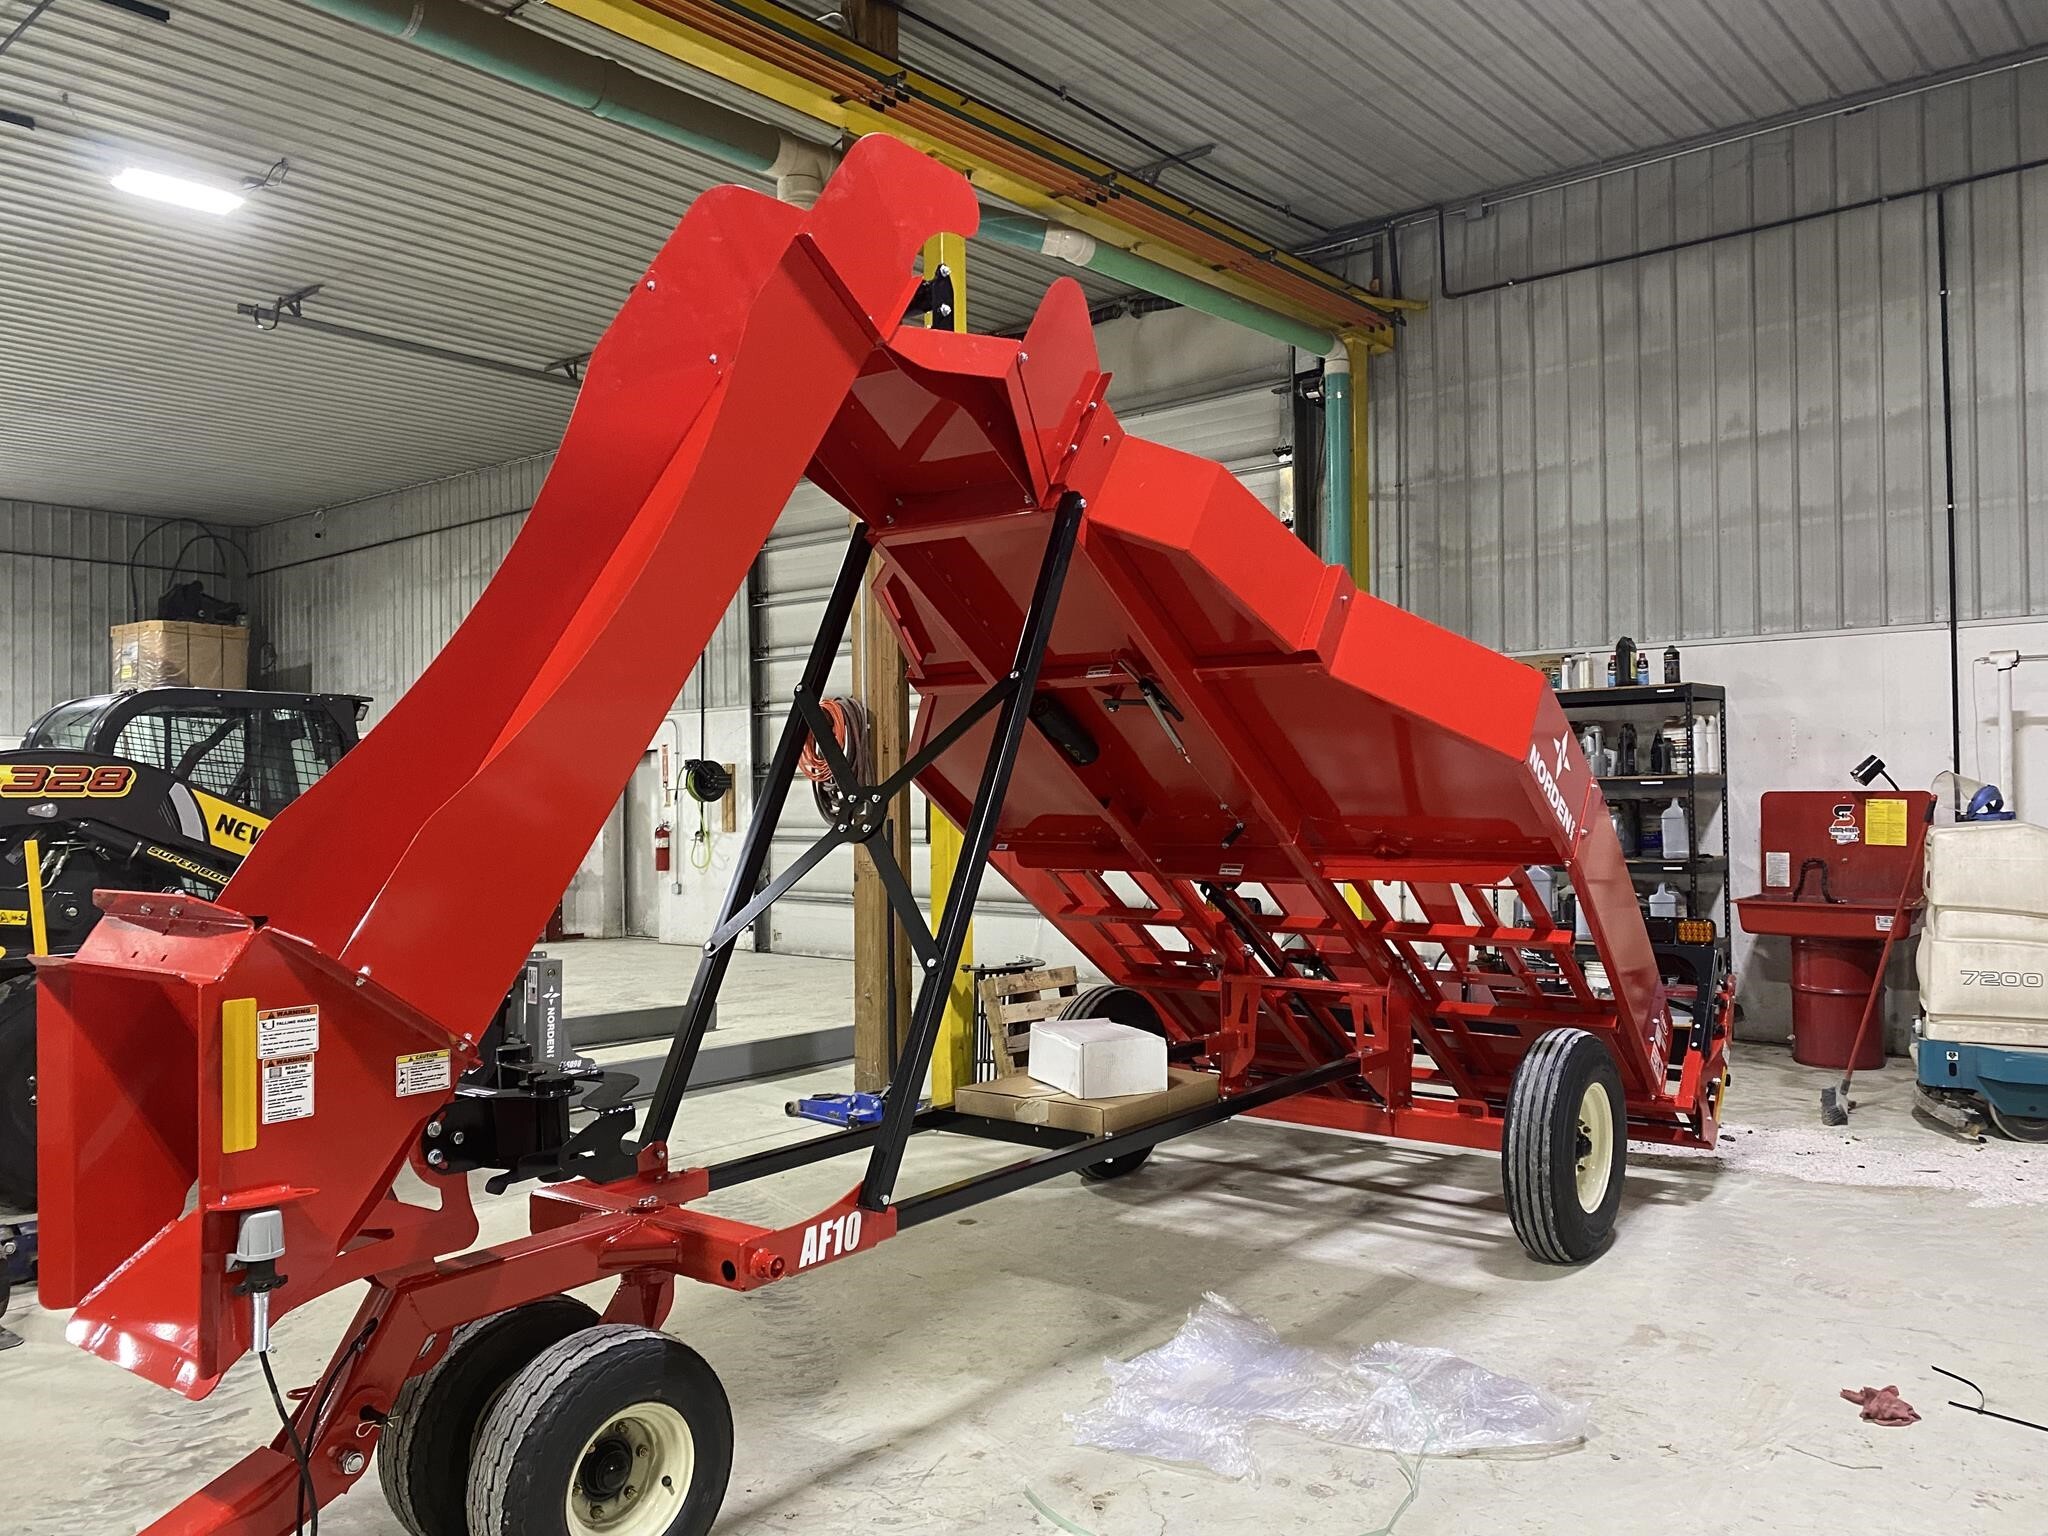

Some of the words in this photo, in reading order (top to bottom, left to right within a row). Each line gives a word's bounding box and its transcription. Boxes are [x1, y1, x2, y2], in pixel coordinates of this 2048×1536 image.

[1, 766, 133, 793] 328
[148, 846, 200, 873] SUPER
[1960, 970, 2044, 988] 7200
[798, 1210, 862, 1269] AF10
